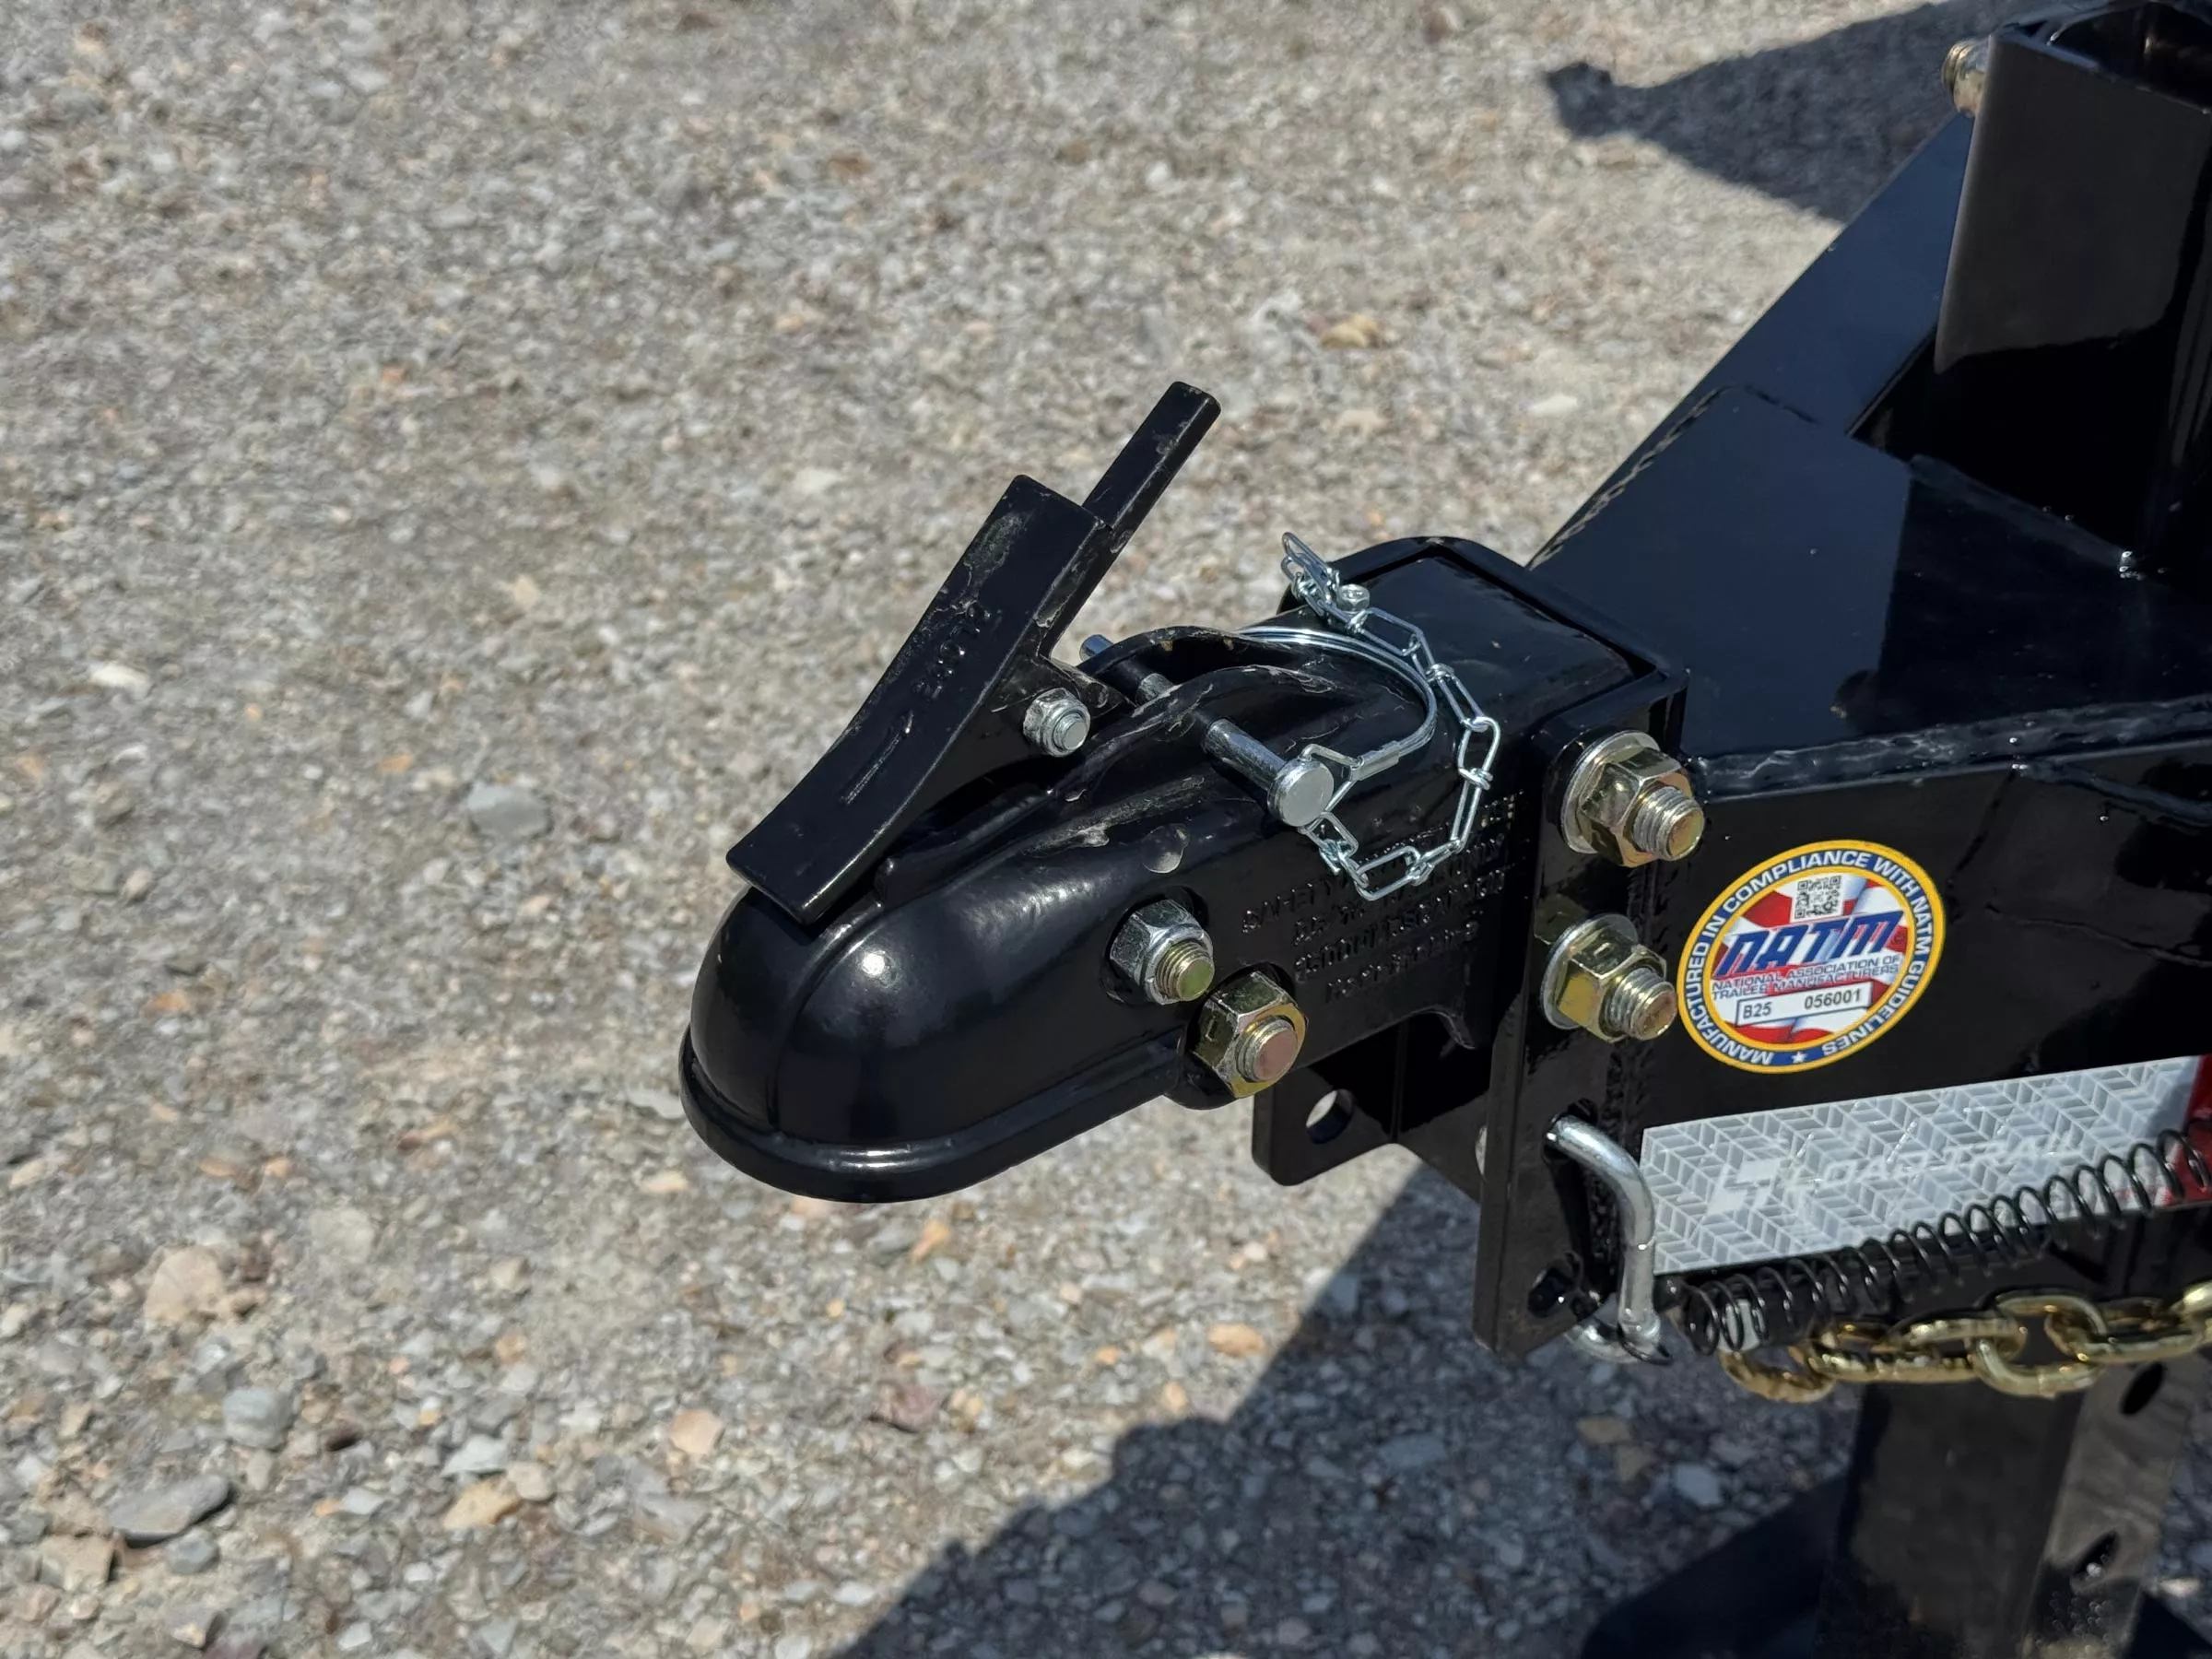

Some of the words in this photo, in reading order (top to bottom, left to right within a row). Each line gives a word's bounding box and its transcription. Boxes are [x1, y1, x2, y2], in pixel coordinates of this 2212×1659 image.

[1722, 850, 1872, 915] COMPLIANCE
[1873, 856, 1922, 896] WITH
[1702, 915, 1724, 942] IN
[1713, 910, 1904, 978] NATM
[1912, 891, 1933, 955] NATM
[1712, 972, 1782, 991] NATIONAL
[1786, 959, 1878, 978] ASSOCIATION
[1882, 955, 1900, 965] OF
[1773, 963, 1899, 991] MANUFACTURERS
[1685, 946, 1775, 1065] MANUFACTURED
[1743, 1001, 1771, 1019] B25
[1805, 988, 1861, 1010] 056001
[1822, 959, 1925, 1056] GUIDELINES
